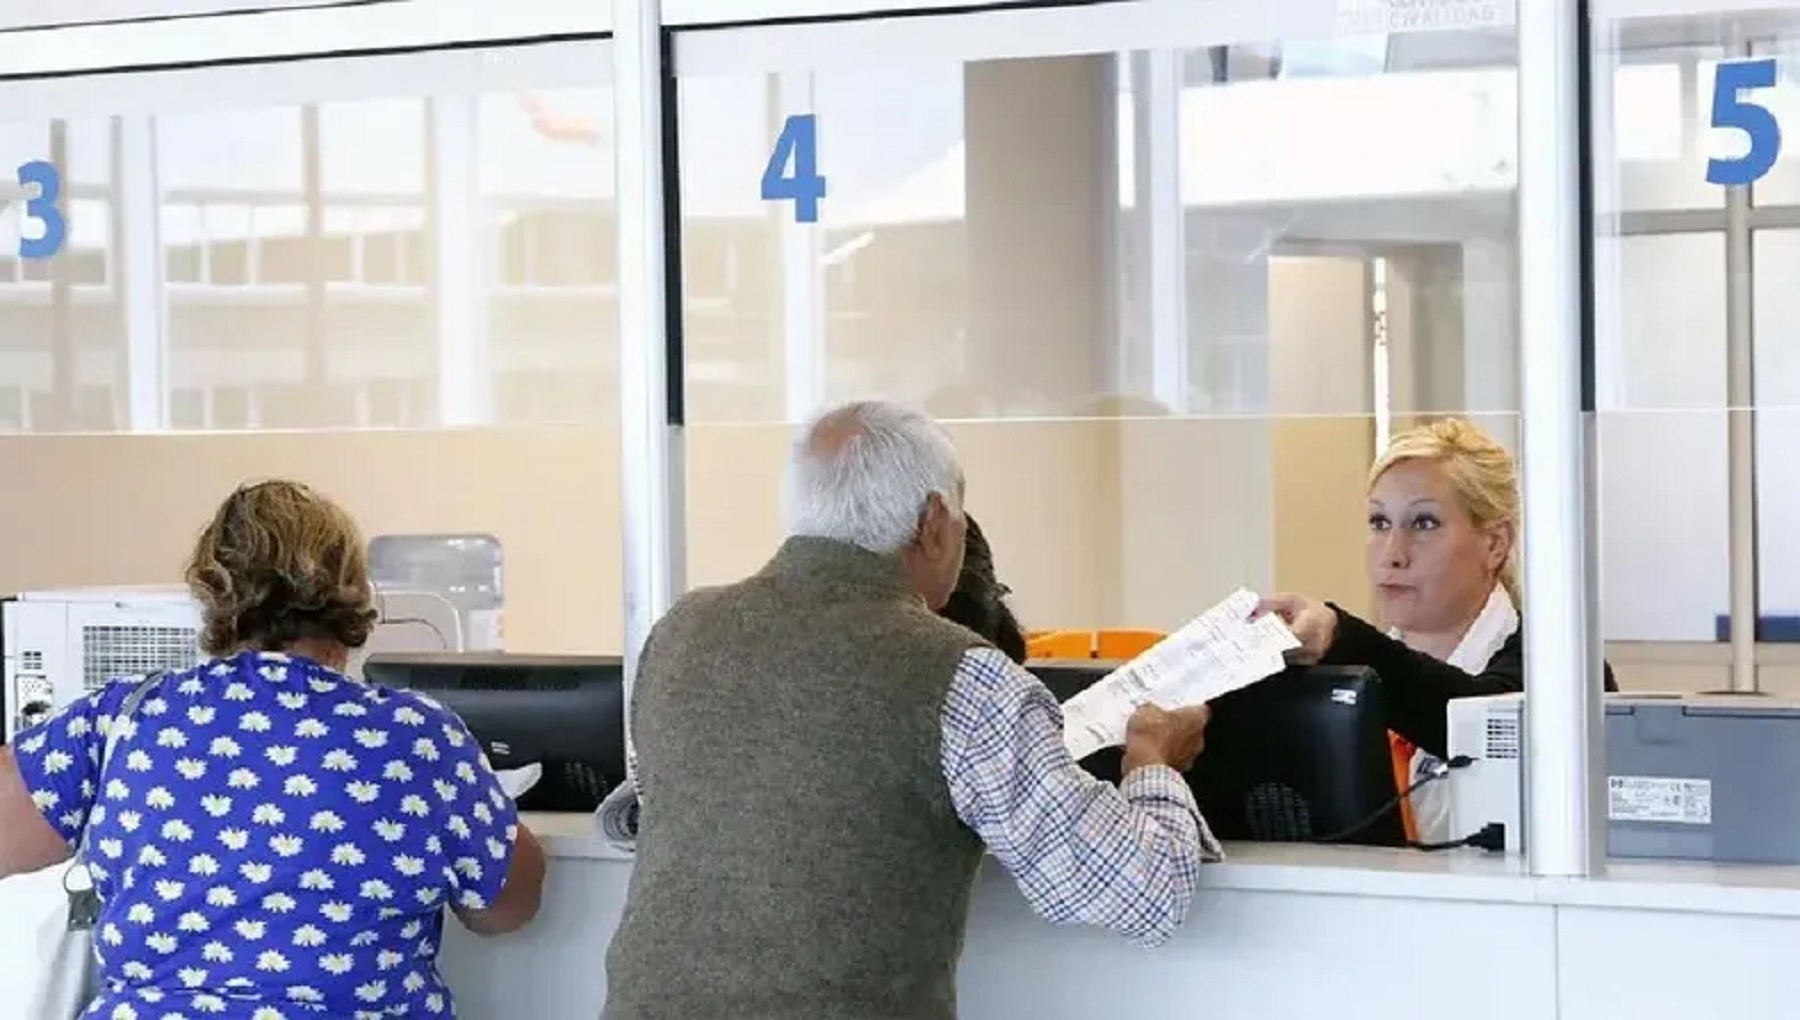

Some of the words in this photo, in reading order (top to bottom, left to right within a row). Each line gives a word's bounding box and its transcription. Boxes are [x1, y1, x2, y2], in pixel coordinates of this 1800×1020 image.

[761, 114, 827, 223] 4
[1706, 59, 1781, 185] 5
[17, 159, 66, 258] 3
